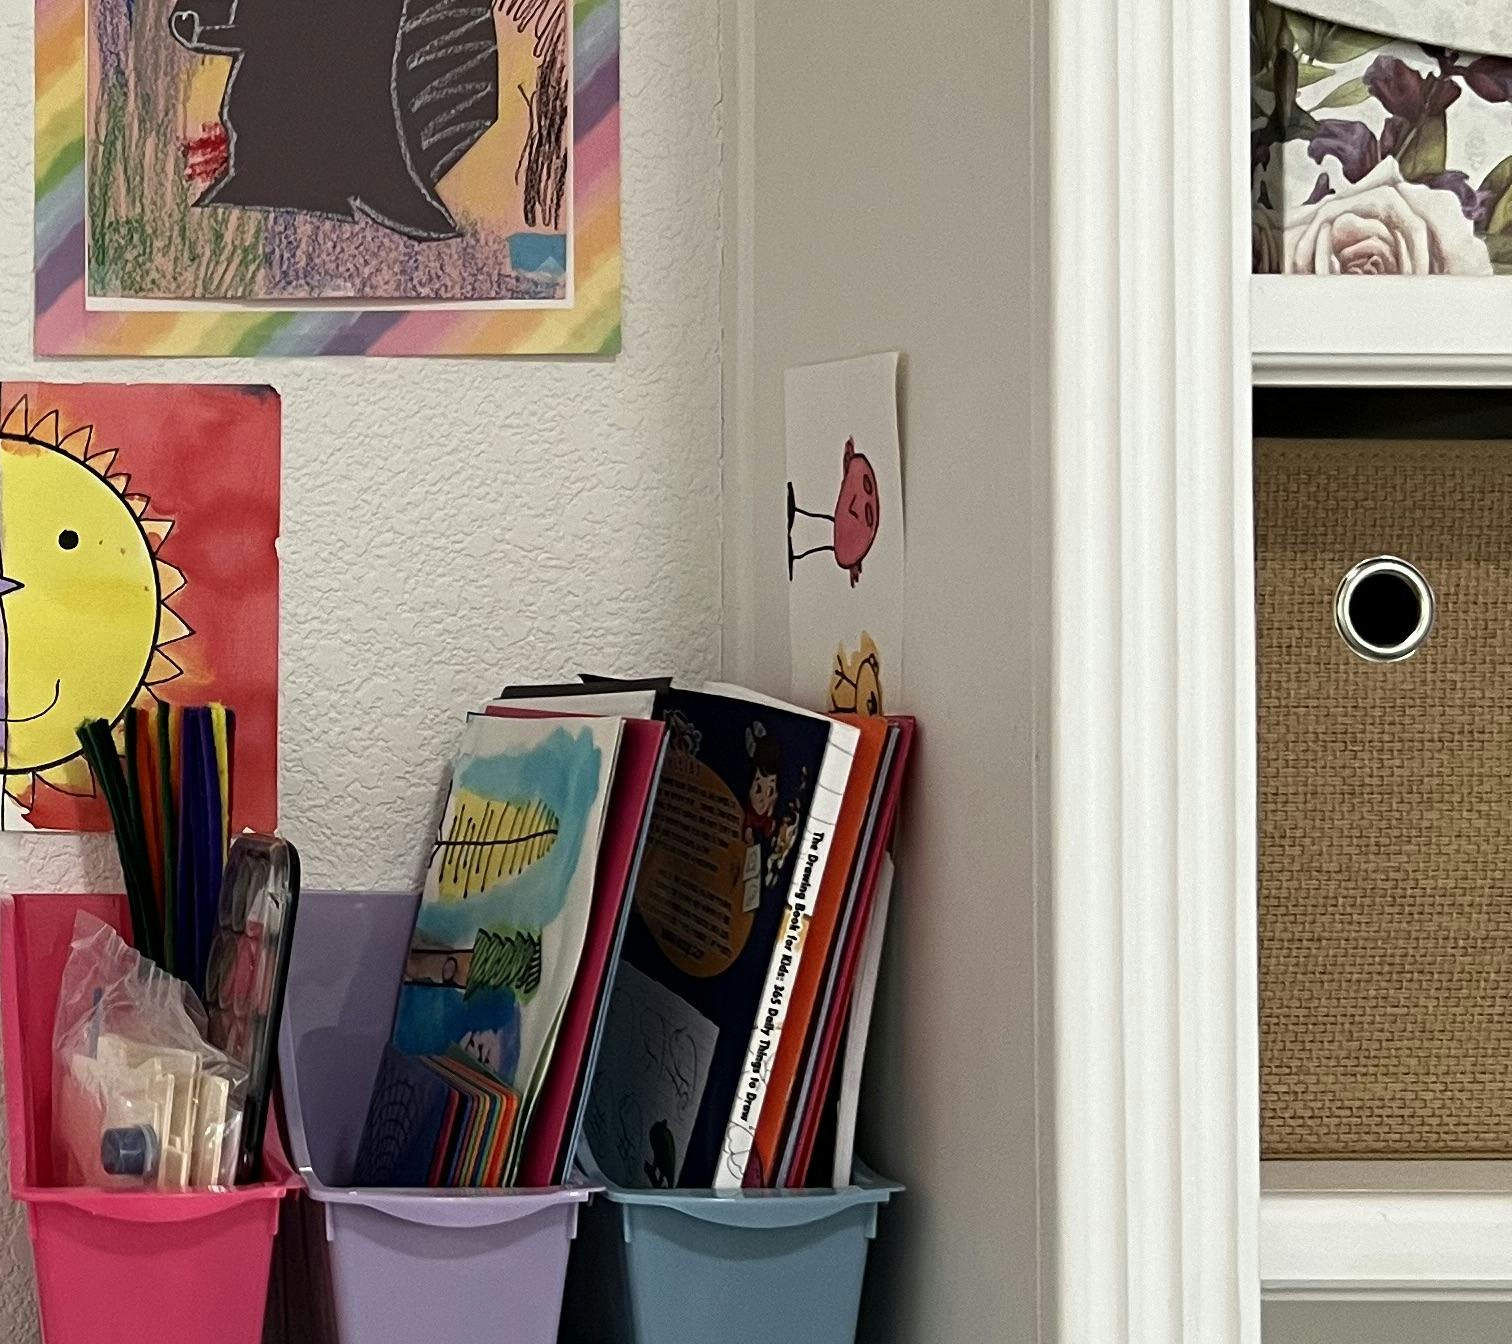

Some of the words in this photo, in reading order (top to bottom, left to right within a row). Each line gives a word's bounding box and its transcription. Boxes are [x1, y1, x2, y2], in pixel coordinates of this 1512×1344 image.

[810, 832, 825, 851] The
[794, 853, 819, 900] Drawing
[789, 903, 806, 931] Book
[784, 935, 798, 952] for
[770, 984, 785, 1005] 365
[760, 1007, 779, 1036] Daily
[751, 1039, 771, 1074] Things
[748, 1076, 760, 1089] to
[740, 1092, 757, 1122] Draw
